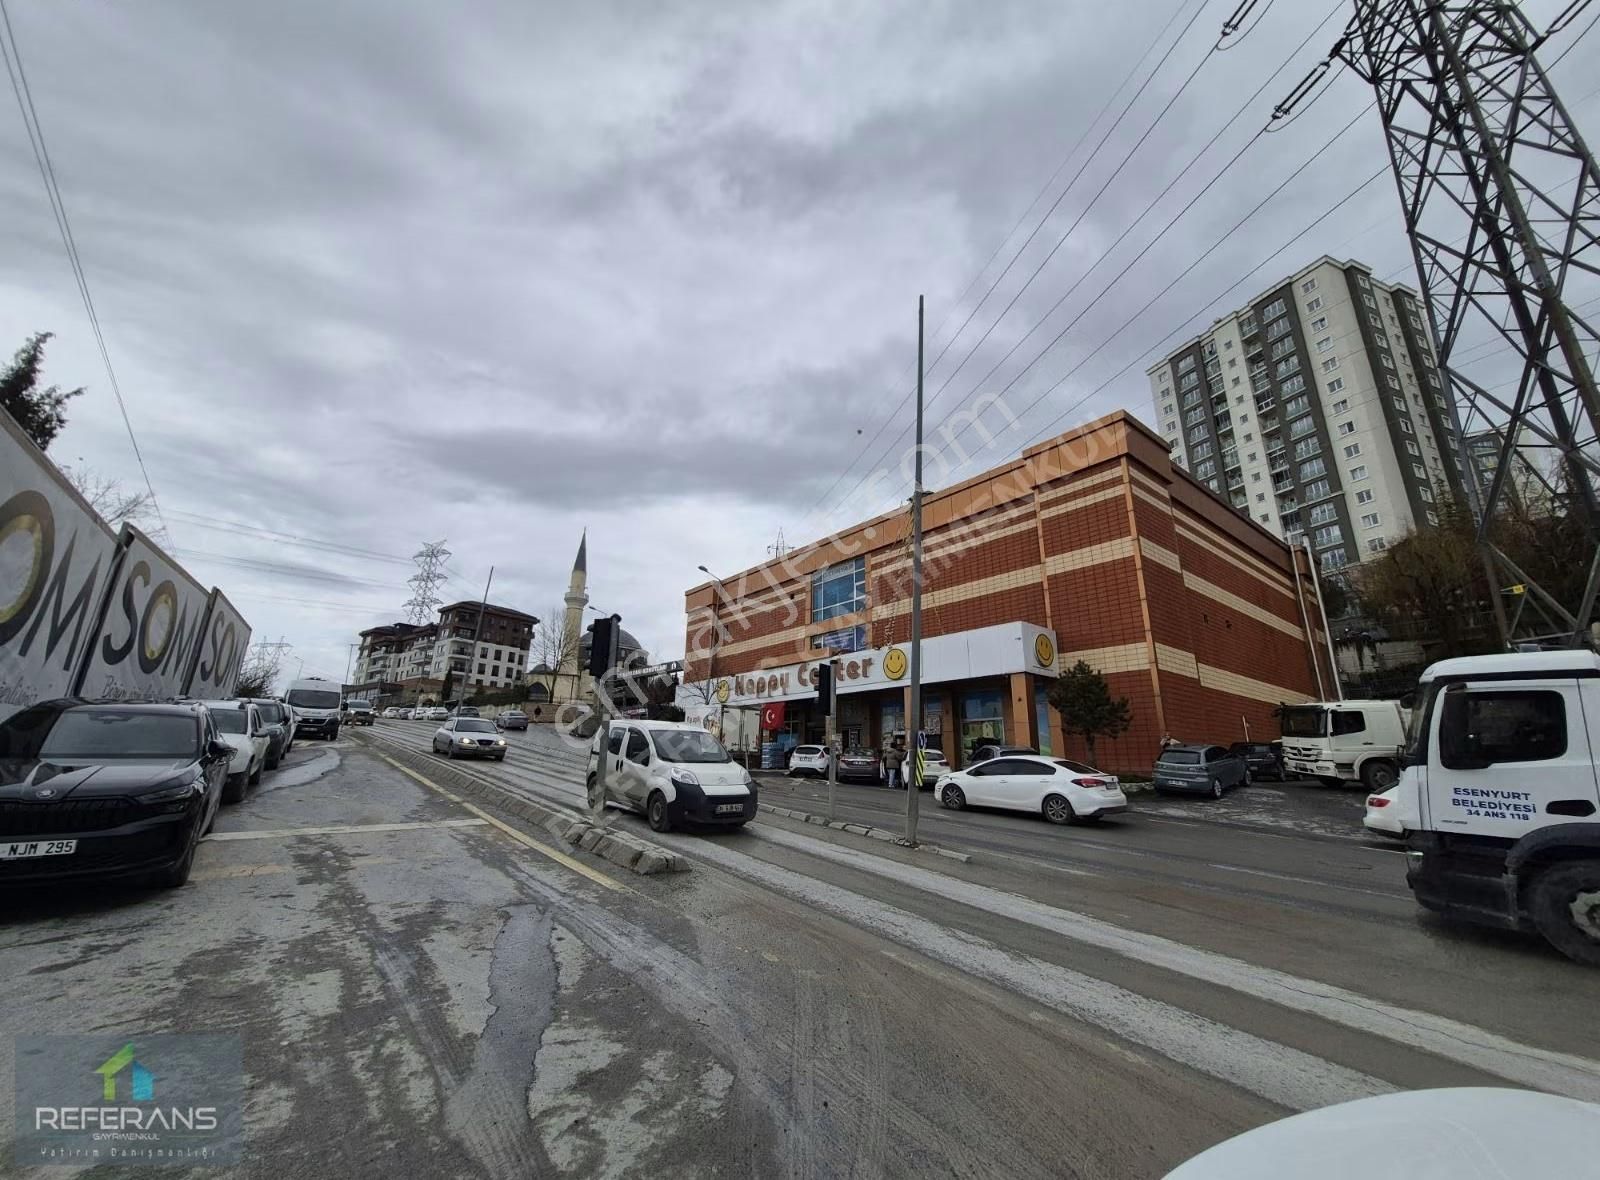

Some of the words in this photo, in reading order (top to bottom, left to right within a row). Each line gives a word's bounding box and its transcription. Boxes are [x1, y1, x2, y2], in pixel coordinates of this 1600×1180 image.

[103, 561, 199, 683] SOM
[735, 673, 790, 699] Happy
[797, 656, 873, 687] Ceter
[1453, 787, 1531, 801] ESENYURT
[1452, 798, 1537, 813] BELEDİYESİ
[1484, 811, 1506, 819] ANS
[1510, 813, 1529, 821] 118
[8, 843, 38, 856] NJM
[45, 841, 74, 854] 295
